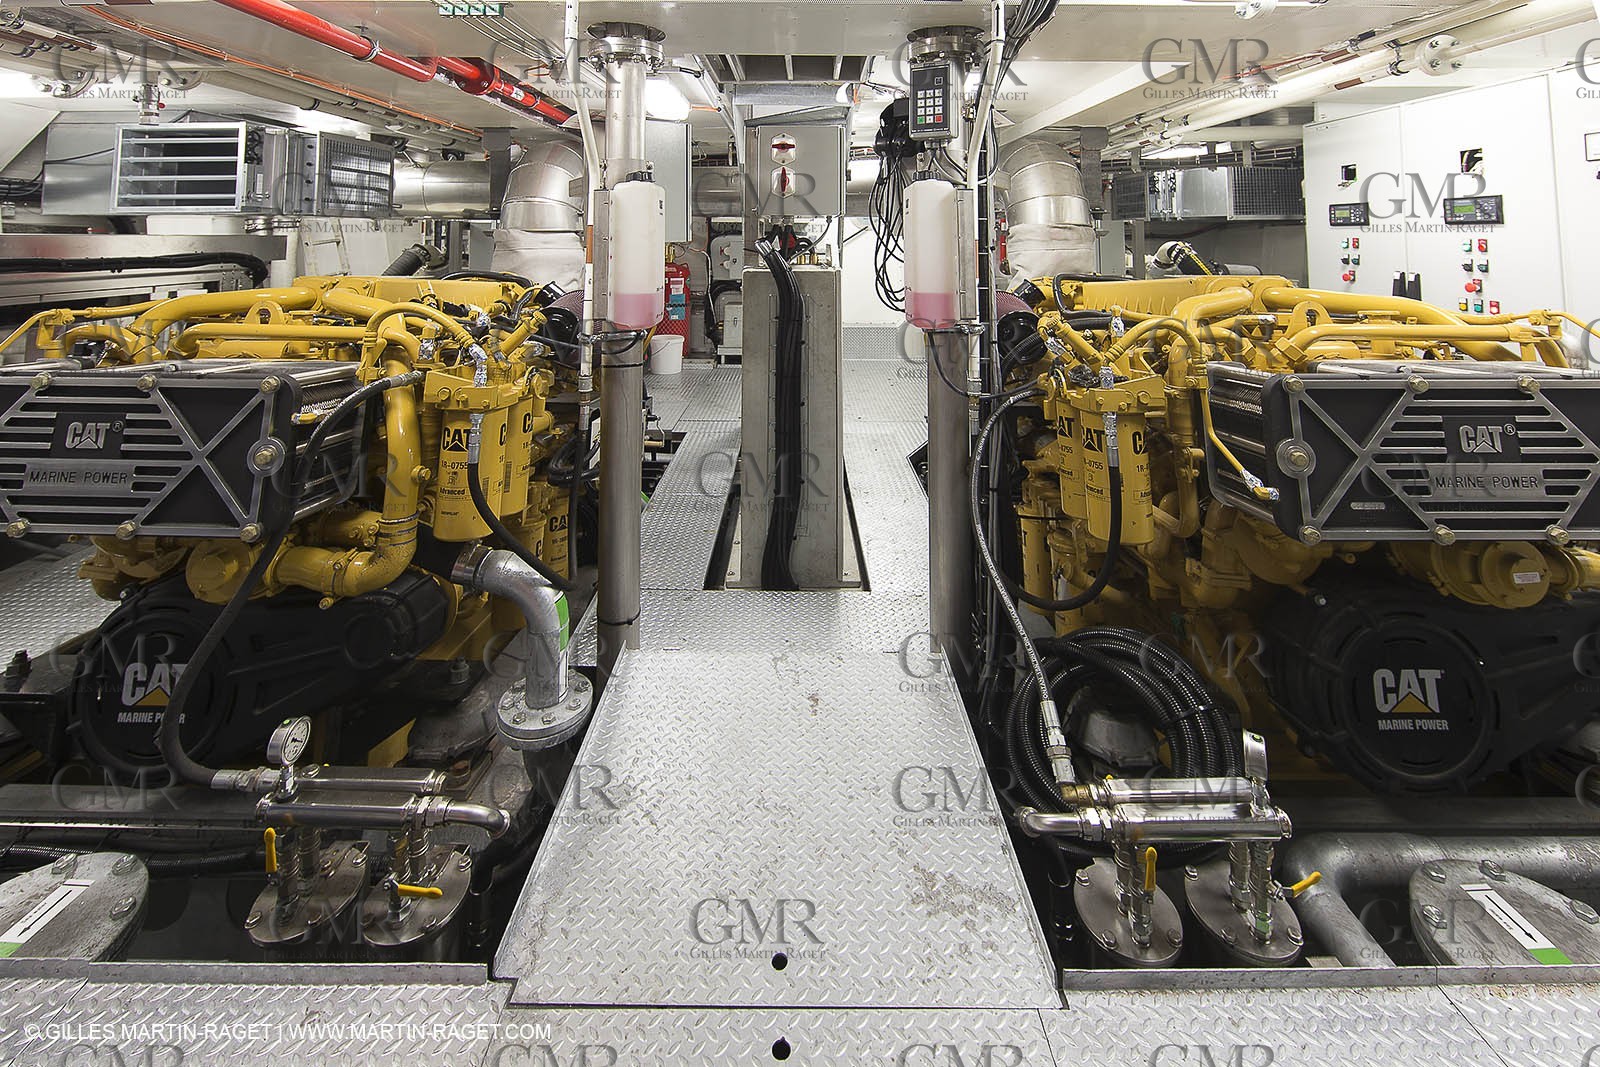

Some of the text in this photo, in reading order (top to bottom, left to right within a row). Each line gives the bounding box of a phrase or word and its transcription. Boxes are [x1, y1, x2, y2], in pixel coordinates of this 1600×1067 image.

[29, 471, 128, 484] MARINE POWER
[1435, 476, 1539, 489] MARINE POWER
[1373, 668, 1442, 714] CAT
[117, 712, 154, 724] MARINE
[1377, 719, 1450, 731] MARINE POWER
